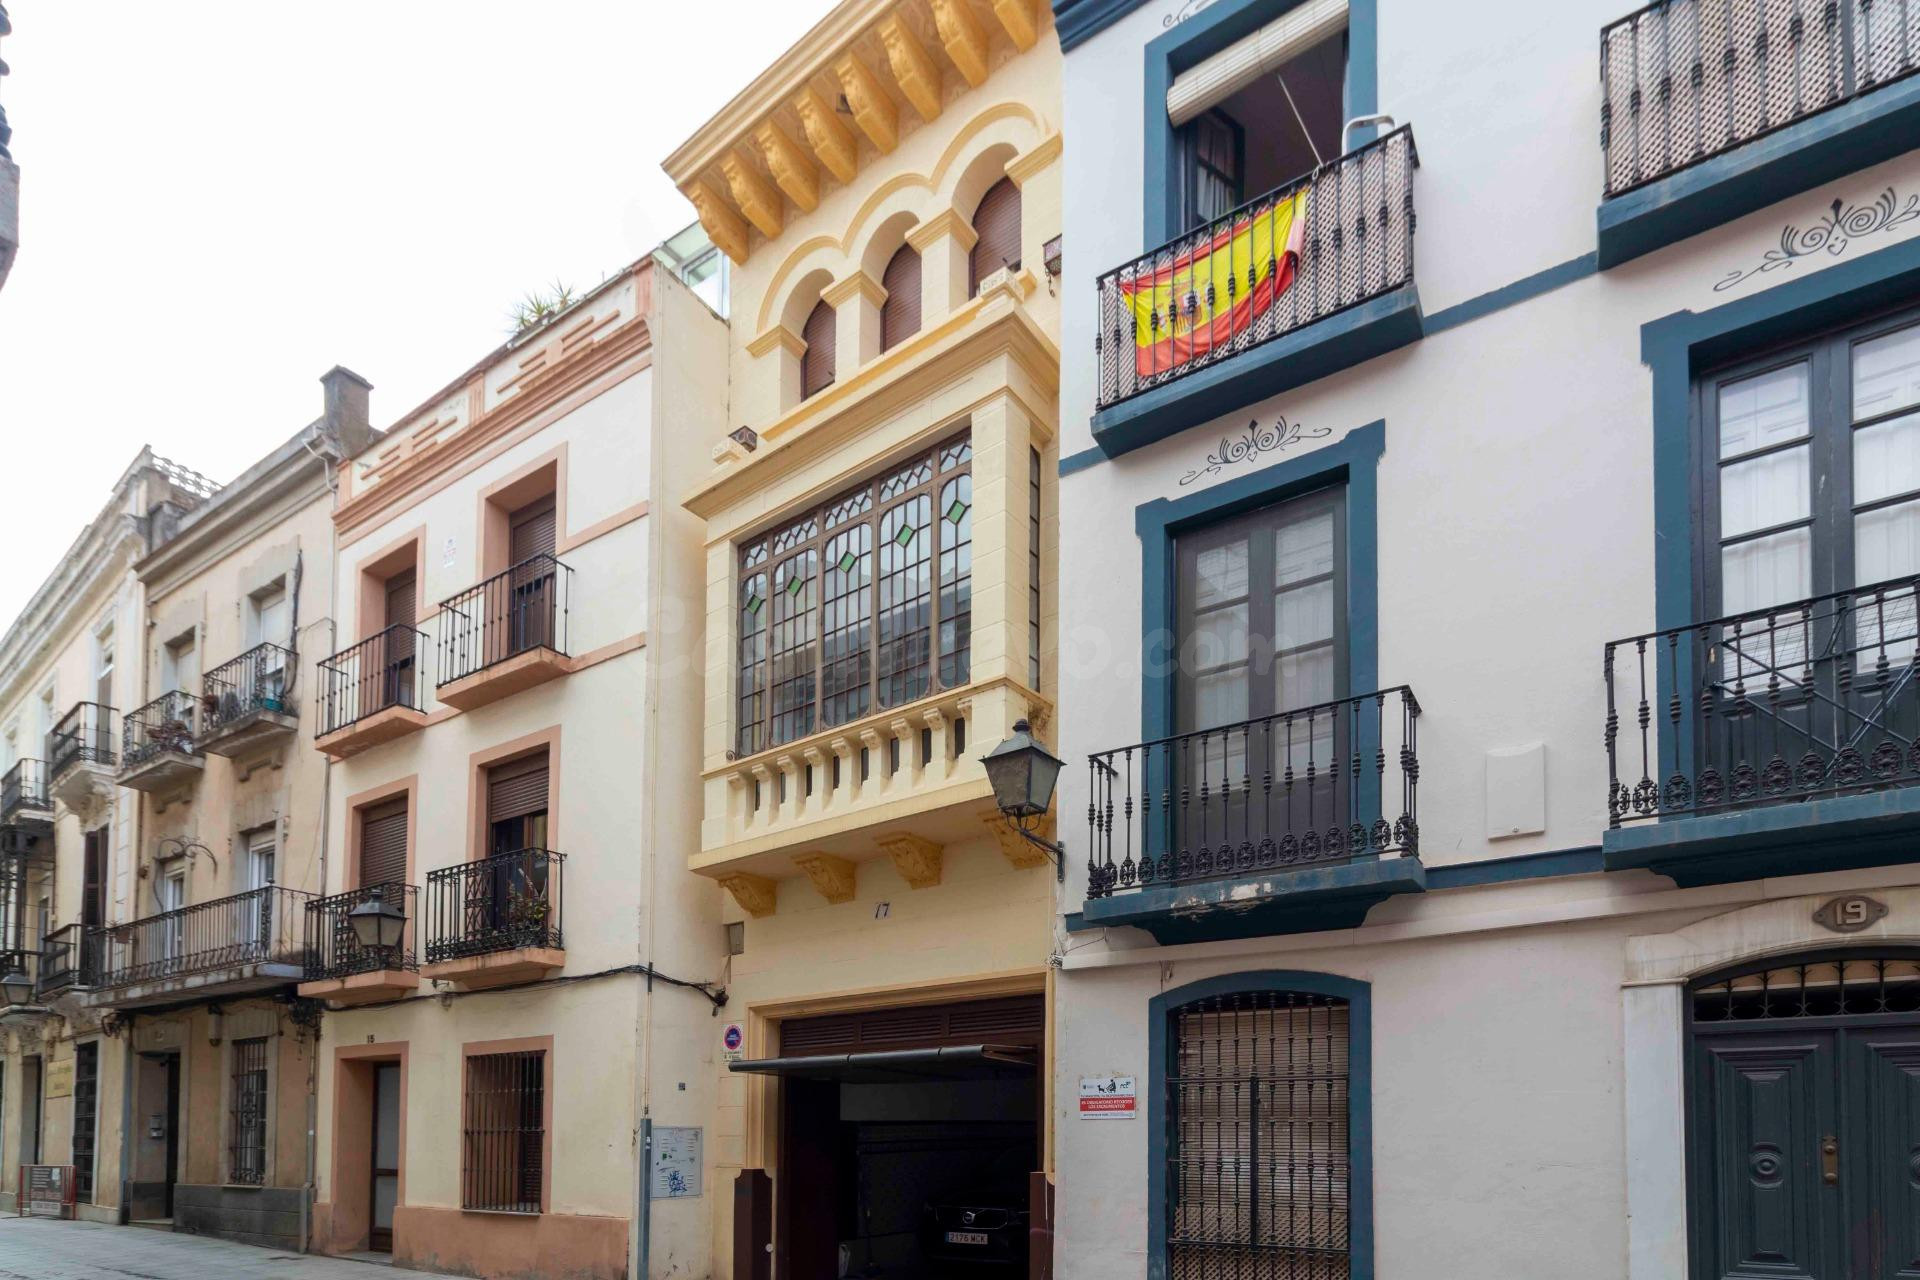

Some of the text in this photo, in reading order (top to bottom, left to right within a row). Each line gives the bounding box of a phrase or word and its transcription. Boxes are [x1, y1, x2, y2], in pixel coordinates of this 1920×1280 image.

[875, 902, 890, 919] 17
[1836, 900, 1867, 925] 19
[367, 1034, 375, 1044] 15
